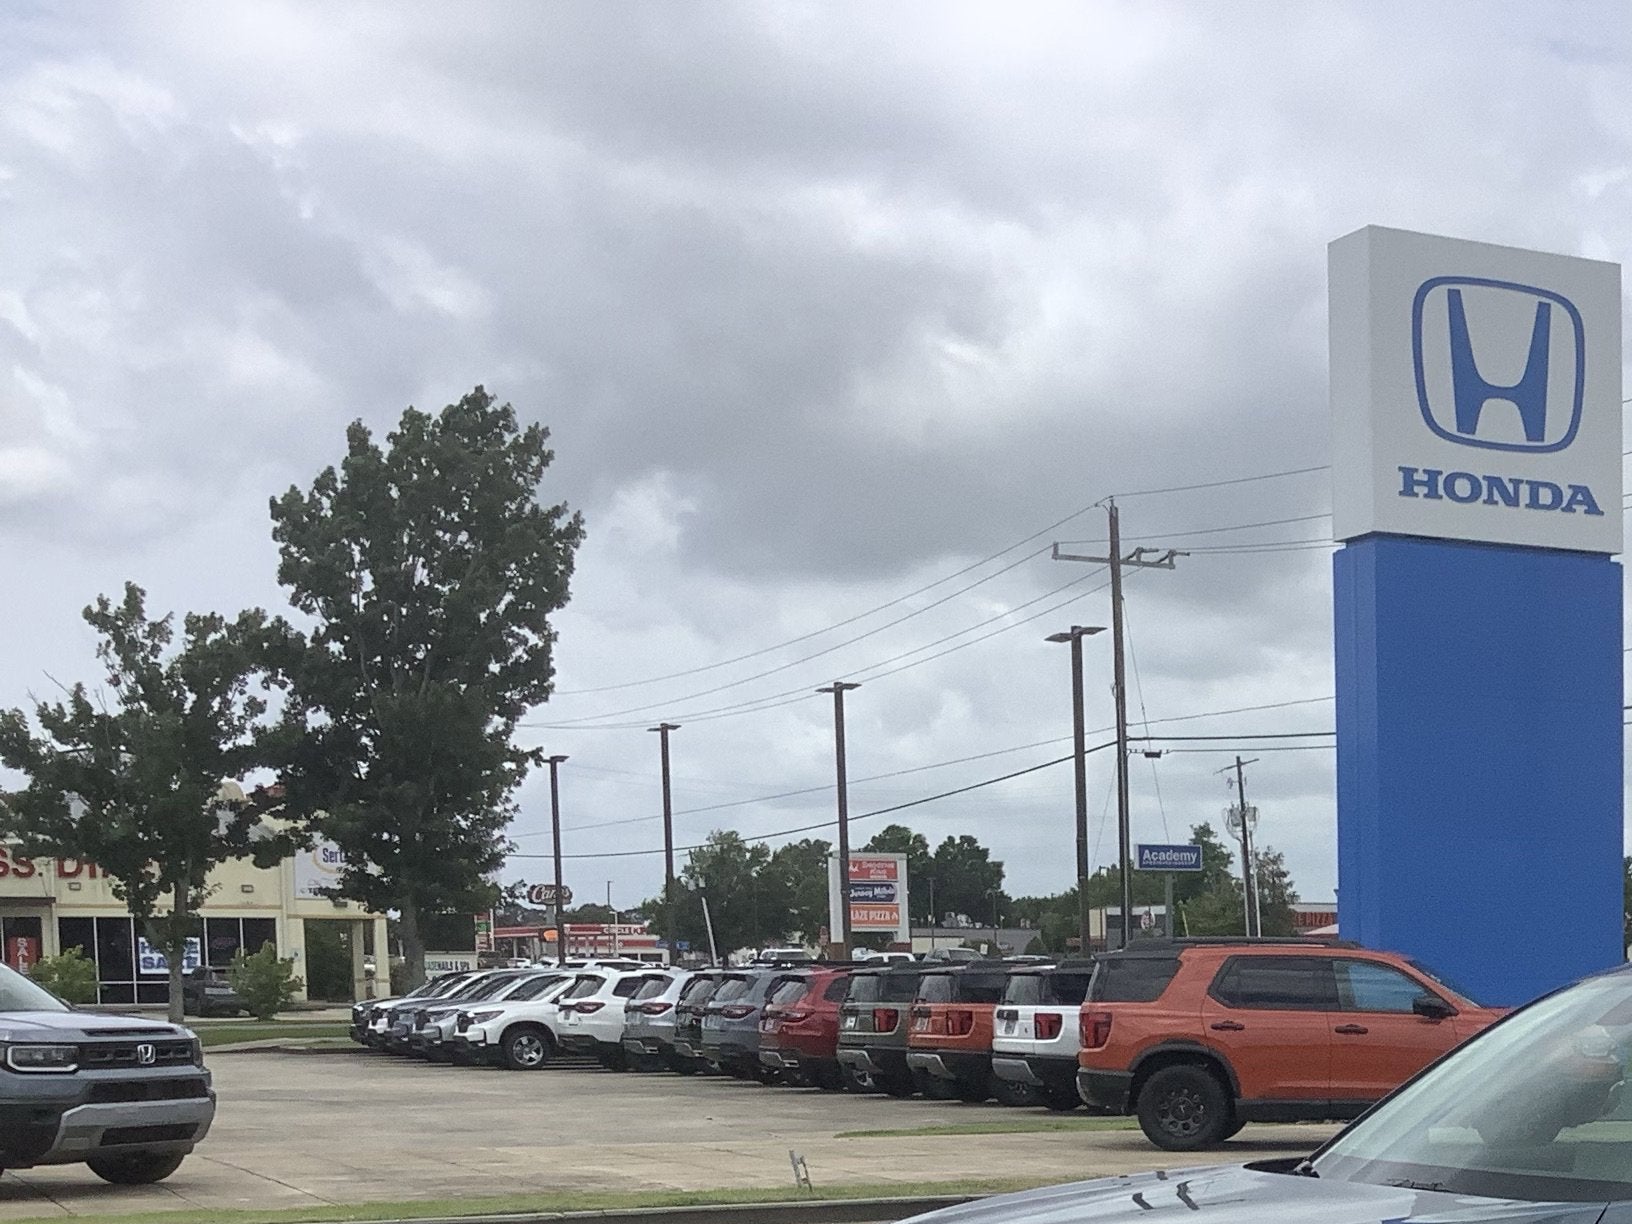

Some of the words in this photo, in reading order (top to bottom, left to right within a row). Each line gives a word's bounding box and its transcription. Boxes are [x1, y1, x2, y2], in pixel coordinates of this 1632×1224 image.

[1398, 466, 1605, 516] HONDA
[1142, 849, 1198, 865] Academy
[850, 910, 869, 921] LAZE
[869, 911, 891, 921] PIZZA
[141, 956, 198, 970] SAE
